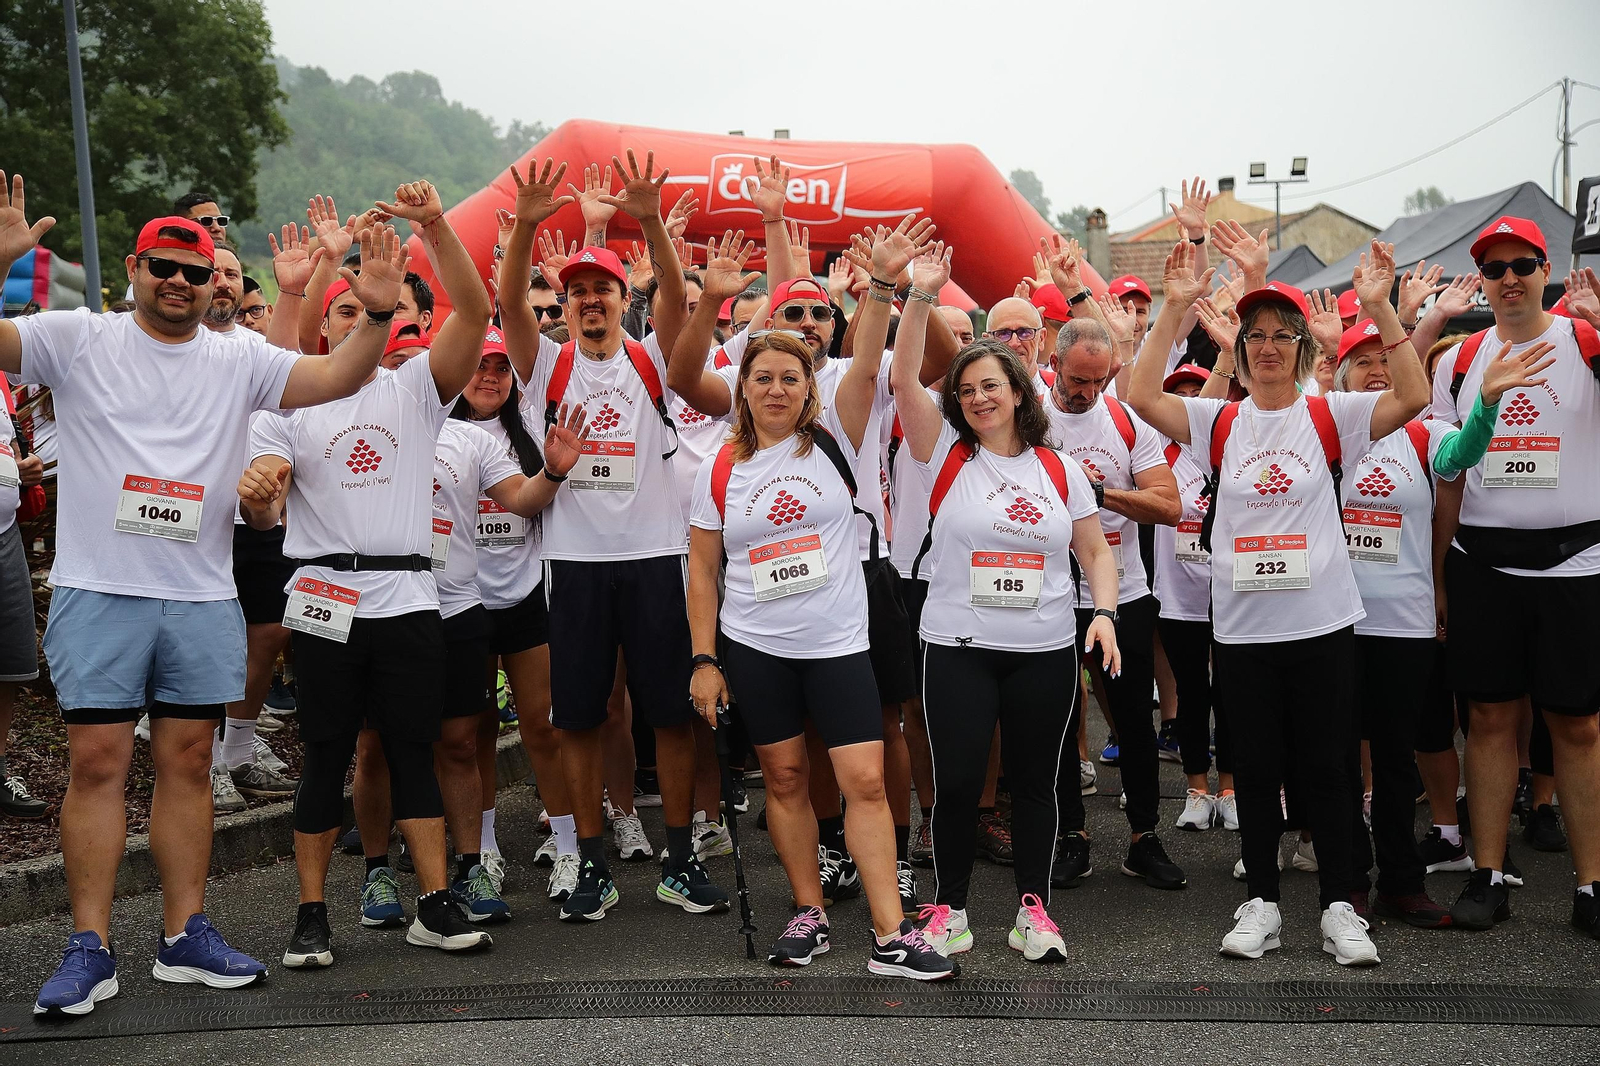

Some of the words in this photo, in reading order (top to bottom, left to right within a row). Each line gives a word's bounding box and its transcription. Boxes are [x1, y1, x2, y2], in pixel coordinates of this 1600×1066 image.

[718, 173, 830, 205] Coen
[330, 425, 361, 446] ANDAINA
[363, 424, 398, 449] CAMPEIRA
[1090, 446, 1121, 471] CAMPEIRA
[1234, 470, 1242, 479] III
[1242, 450, 1277, 469] ANDAINA
[592, 465, 610, 477] 88
[1505, 462, 1536, 473] 200
[138, 481, 152, 489] GSI
[341, 478, 370, 490] Facendo
[180, 488, 201, 496] Mediplus
[745, 506, 753, 516] III
[751, 477, 782, 504] ANDAINA
[784, 476, 822, 497] CAMPEIRA
[146, 496, 177, 505] GIOVANNI
[1247, 498, 1279, 509] Facendo
[138, 505, 181, 523] 1040
[477, 522, 511, 534] 1089
[992, 523, 1026, 537] Facendo
[1190, 541, 1204, 551] 11
[1346, 534, 1382, 548] 1106
[762, 548, 774, 557] GSI
[771, 556, 802, 566] MOROCHA
[770, 563, 809, 583] 1068
[1255, 561, 1287, 575] 232
[304, 582, 316, 590] GSI
[994, 579, 1024, 592] 185
[302, 595, 334, 608] ALEJANDRO
[302, 605, 332, 622] 229
